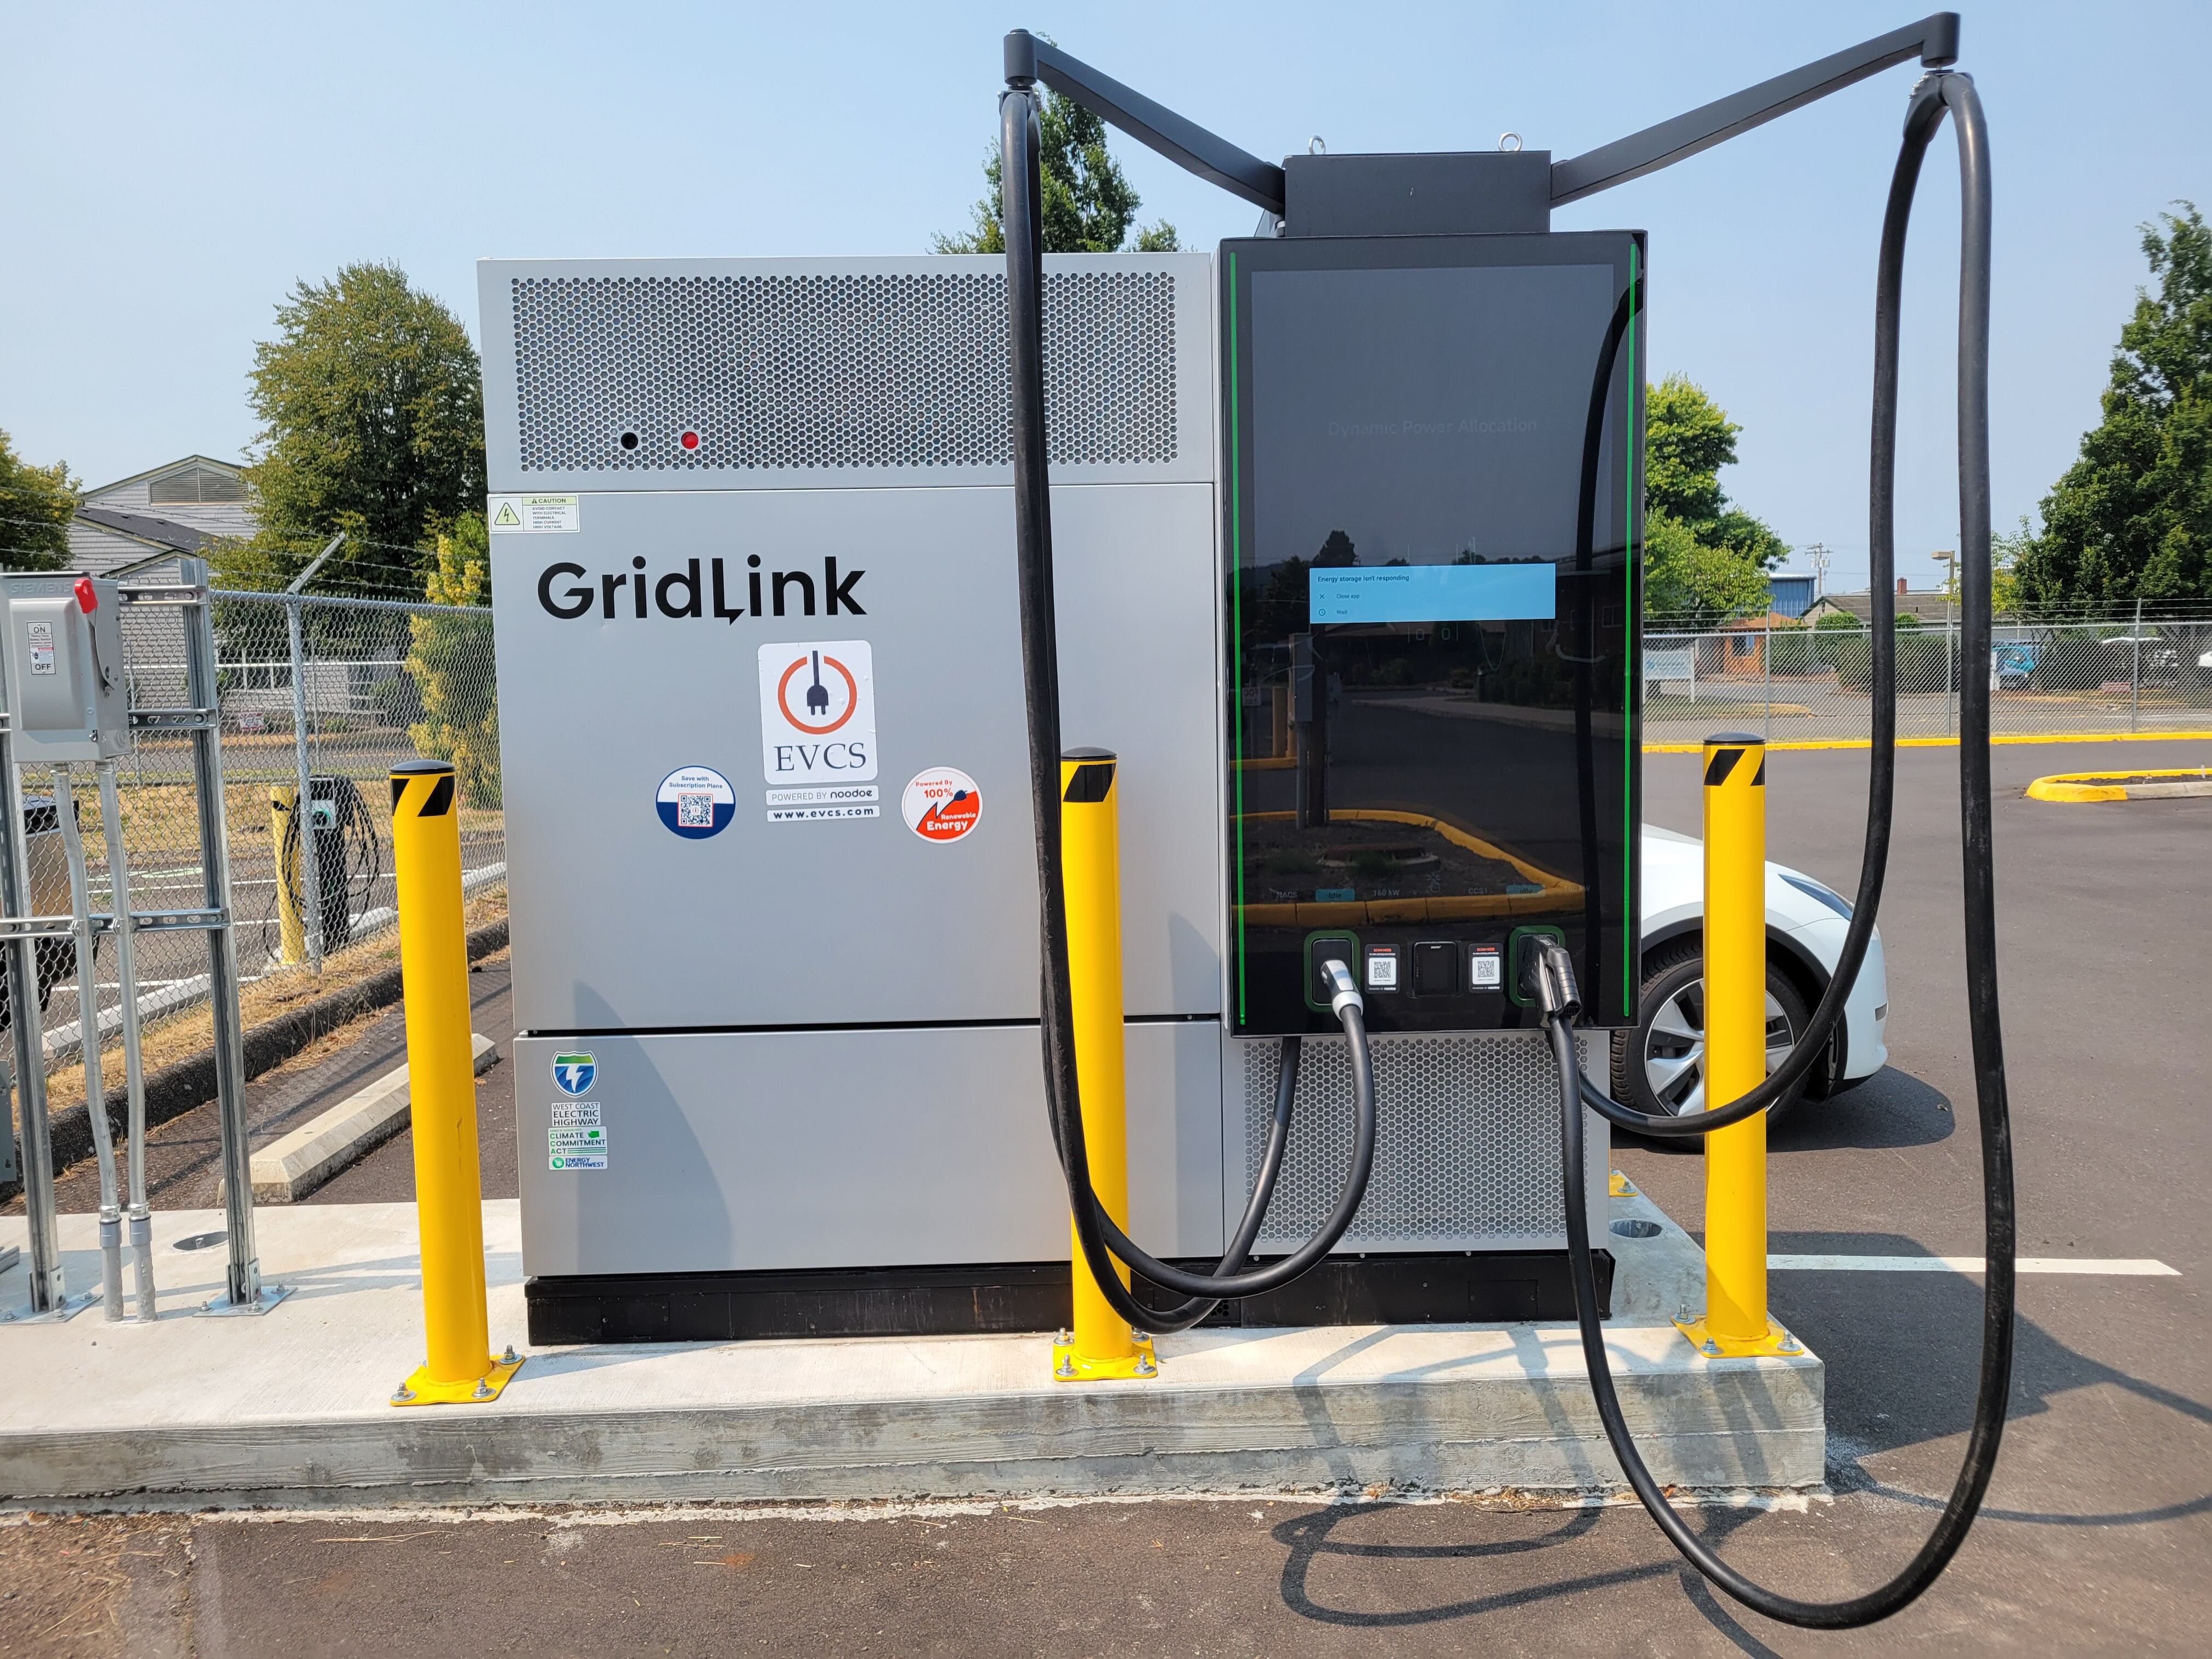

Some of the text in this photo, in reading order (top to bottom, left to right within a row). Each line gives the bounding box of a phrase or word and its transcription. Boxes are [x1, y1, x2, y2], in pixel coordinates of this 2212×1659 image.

[1328, 418, 1537, 438] Dynamic Power Allocation
[11, 582, 72, 594] SIEMENS
[537, 554, 867, 625] GridLink
[774, 742, 866, 771] EVCS
[772, 793, 814, 801] POWERED
[830, 788, 873, 799] noodoe
[924, 787, 953, 799] 100%
[774, 808, 873, 819] www.evcs.com
[941, 812, 976, 820] Renewable
[927, 821, 968, 831] Energy
[554, 1110, 599, 1118] ELECTRIC
